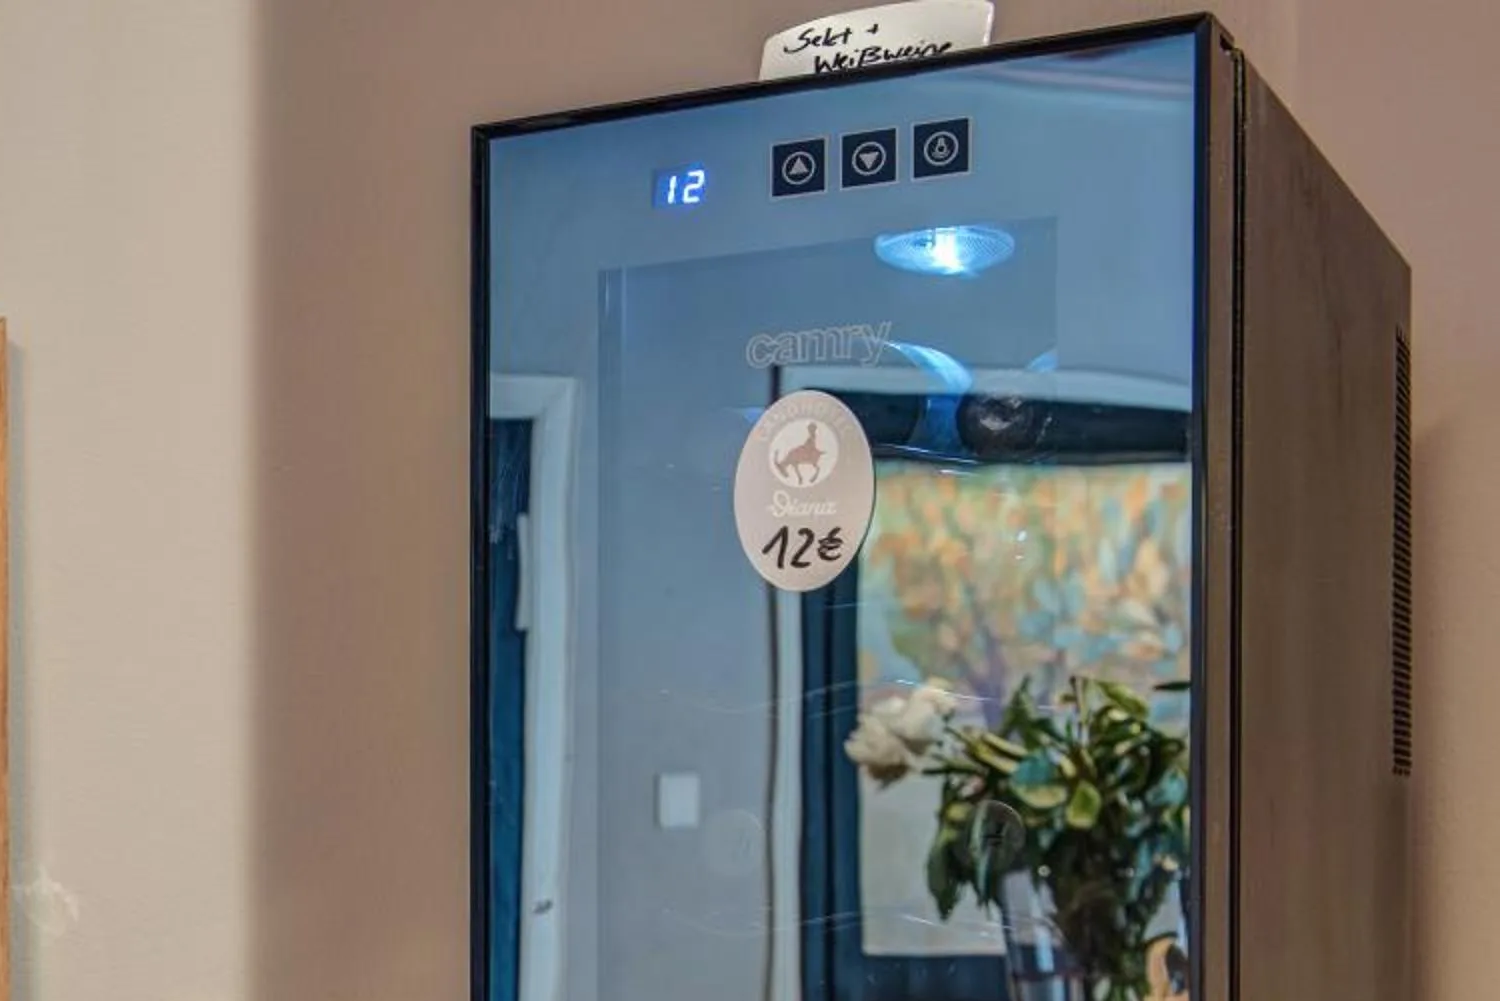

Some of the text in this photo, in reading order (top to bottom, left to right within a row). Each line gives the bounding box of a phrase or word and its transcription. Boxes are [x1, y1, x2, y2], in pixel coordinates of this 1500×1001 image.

[783, 27, 852, 54] Sekt
[666, 171, 705, 205] 12
[746, 322, 892, 369] camry
